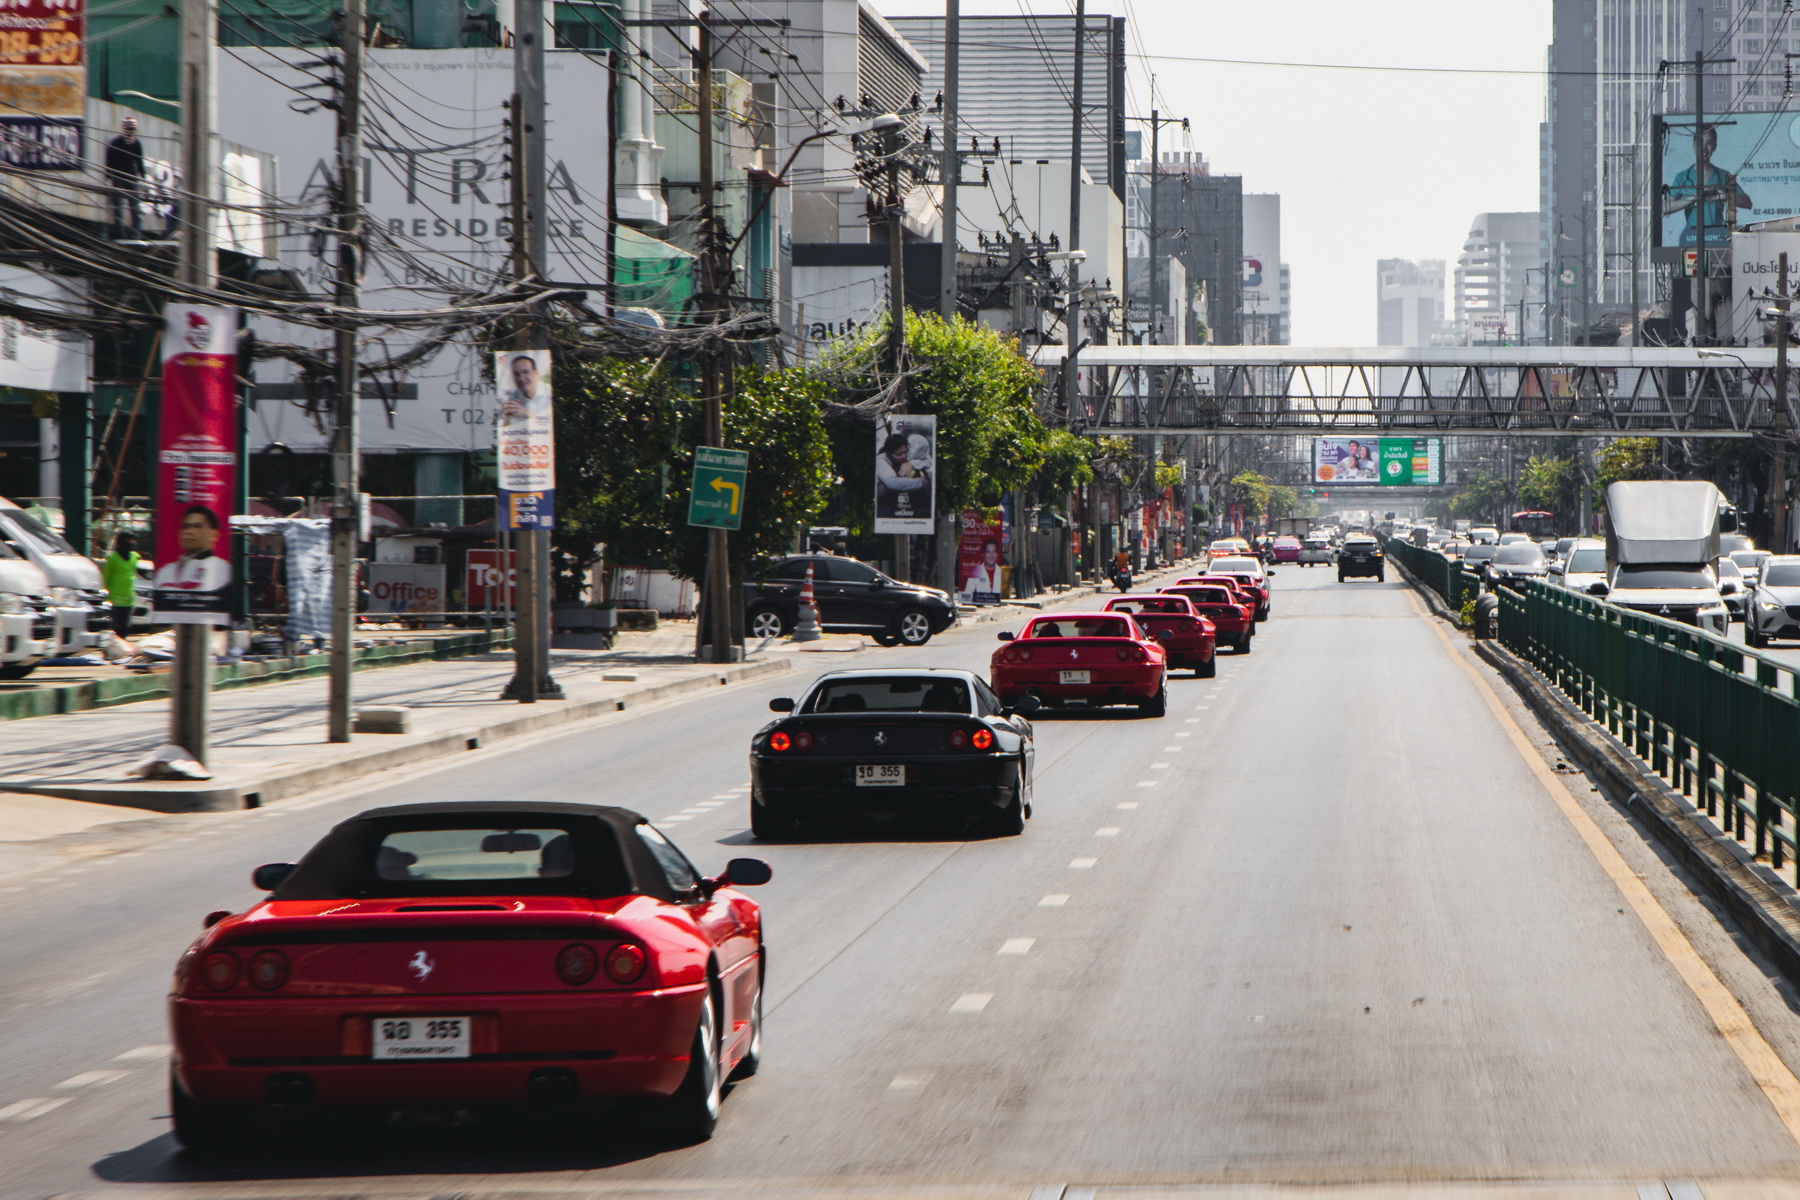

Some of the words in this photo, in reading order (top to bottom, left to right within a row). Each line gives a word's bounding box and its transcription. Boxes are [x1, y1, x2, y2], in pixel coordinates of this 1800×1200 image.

[388, 217, 585, 238] RESIDECE
[1742, 260, 1799, 274] มีประโยน์
[441, 408, 456, 424] T
[462, 408, 485, 425] 02
[502, 445, 550, 457] 40,000
[963, 518, 976, 528] 30
[373, 581, 439, 601] Office
[880, 766, 900, 777] 355
[426, 1019, 462, 1039] 355
